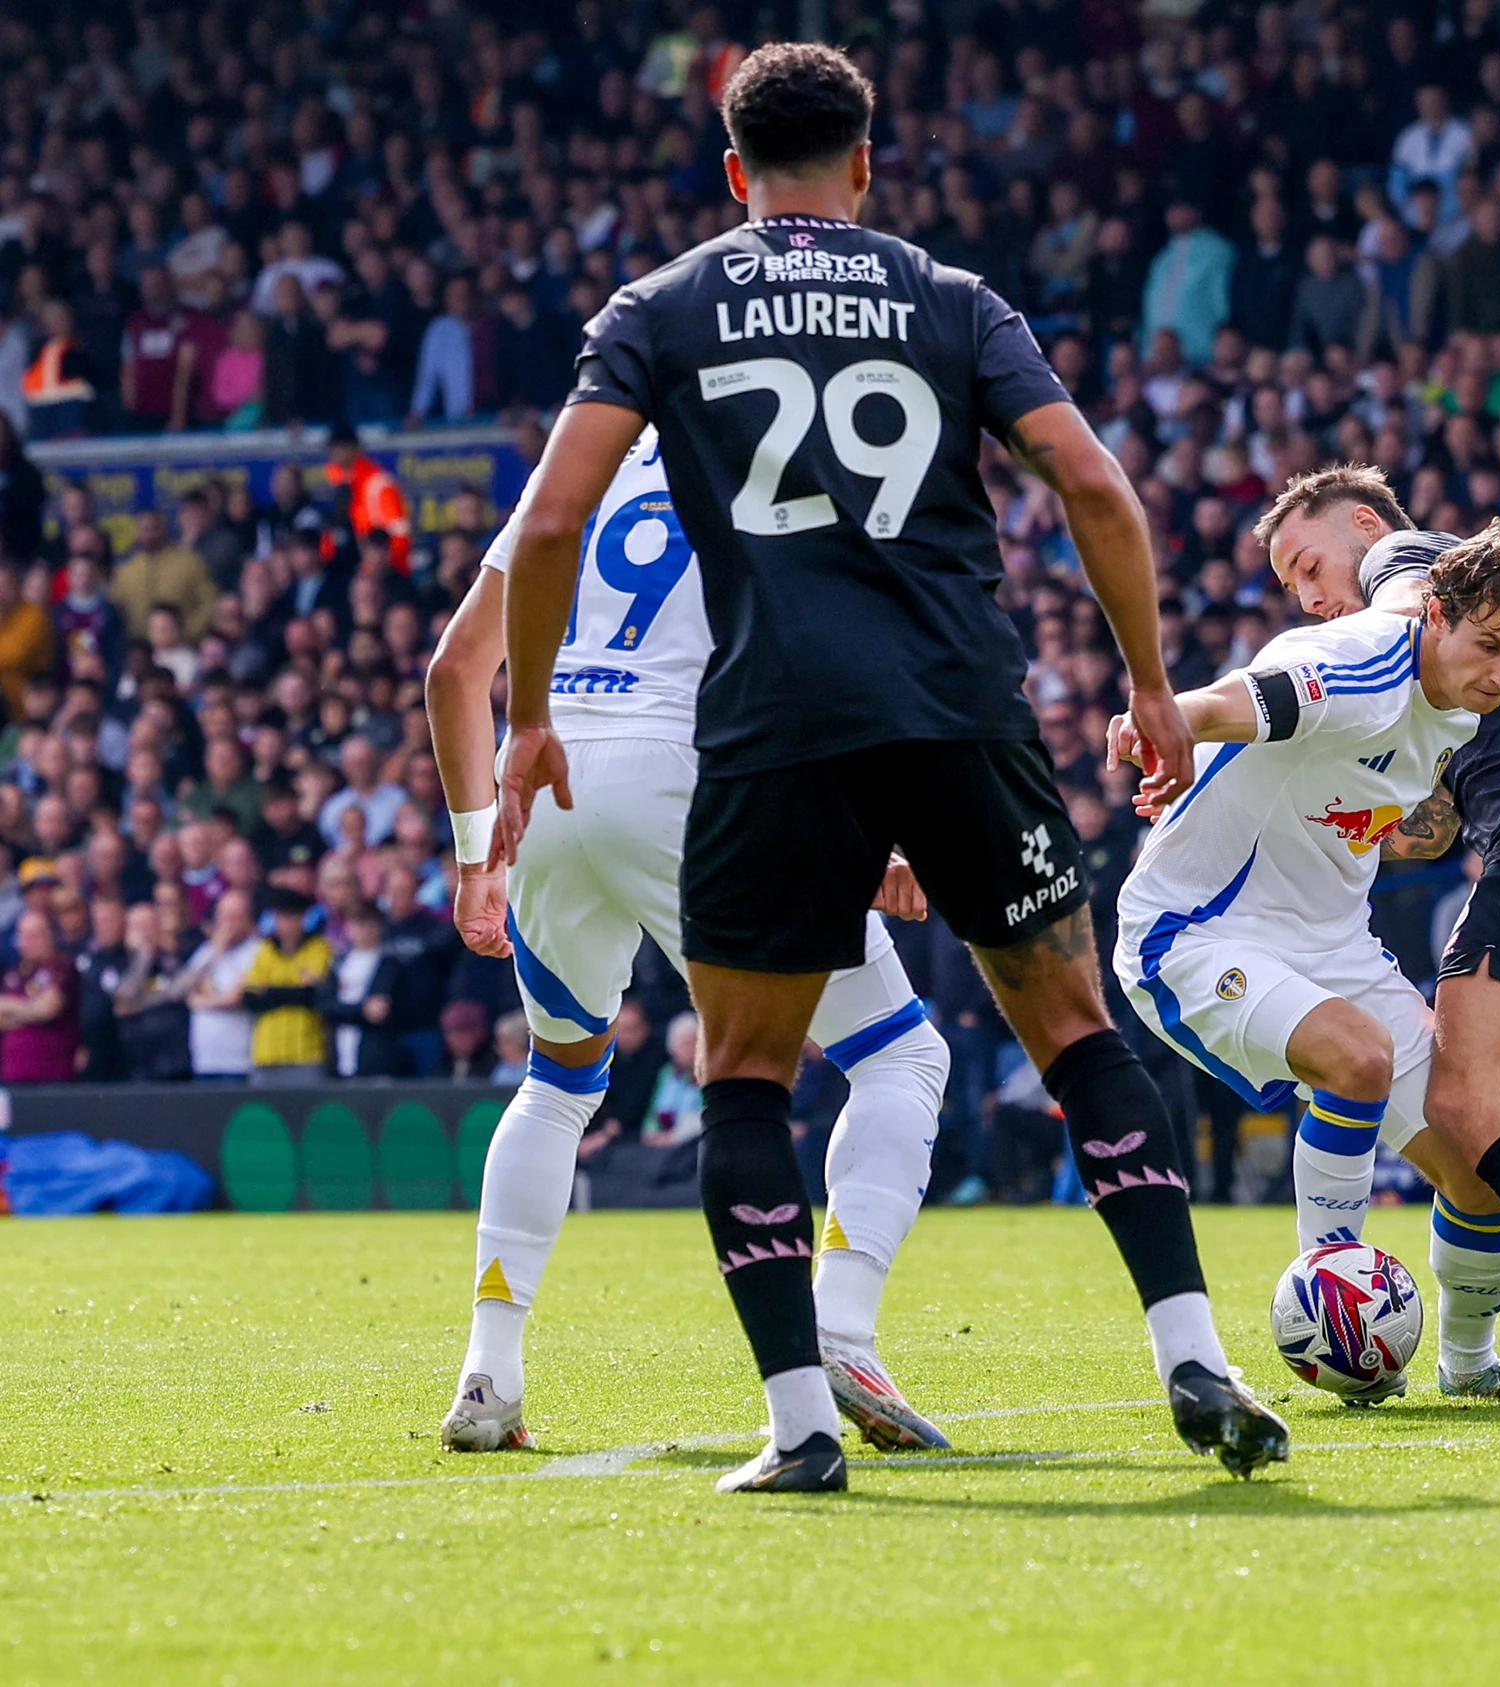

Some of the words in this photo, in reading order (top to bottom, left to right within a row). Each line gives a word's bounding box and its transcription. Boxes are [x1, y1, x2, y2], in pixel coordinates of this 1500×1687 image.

[764, 250, 887, 274] BRISTOL
[764, 267, 888, 286] STREET.CO.UK
[717, 291, 915, 342] LAURENT
[698, 358, 942, 539] 29
[1301, 665, 1313, 679] sky
[1308, 681, 1320, 699] bet
[1005, 866, 1079, 926] RAPIDZ
